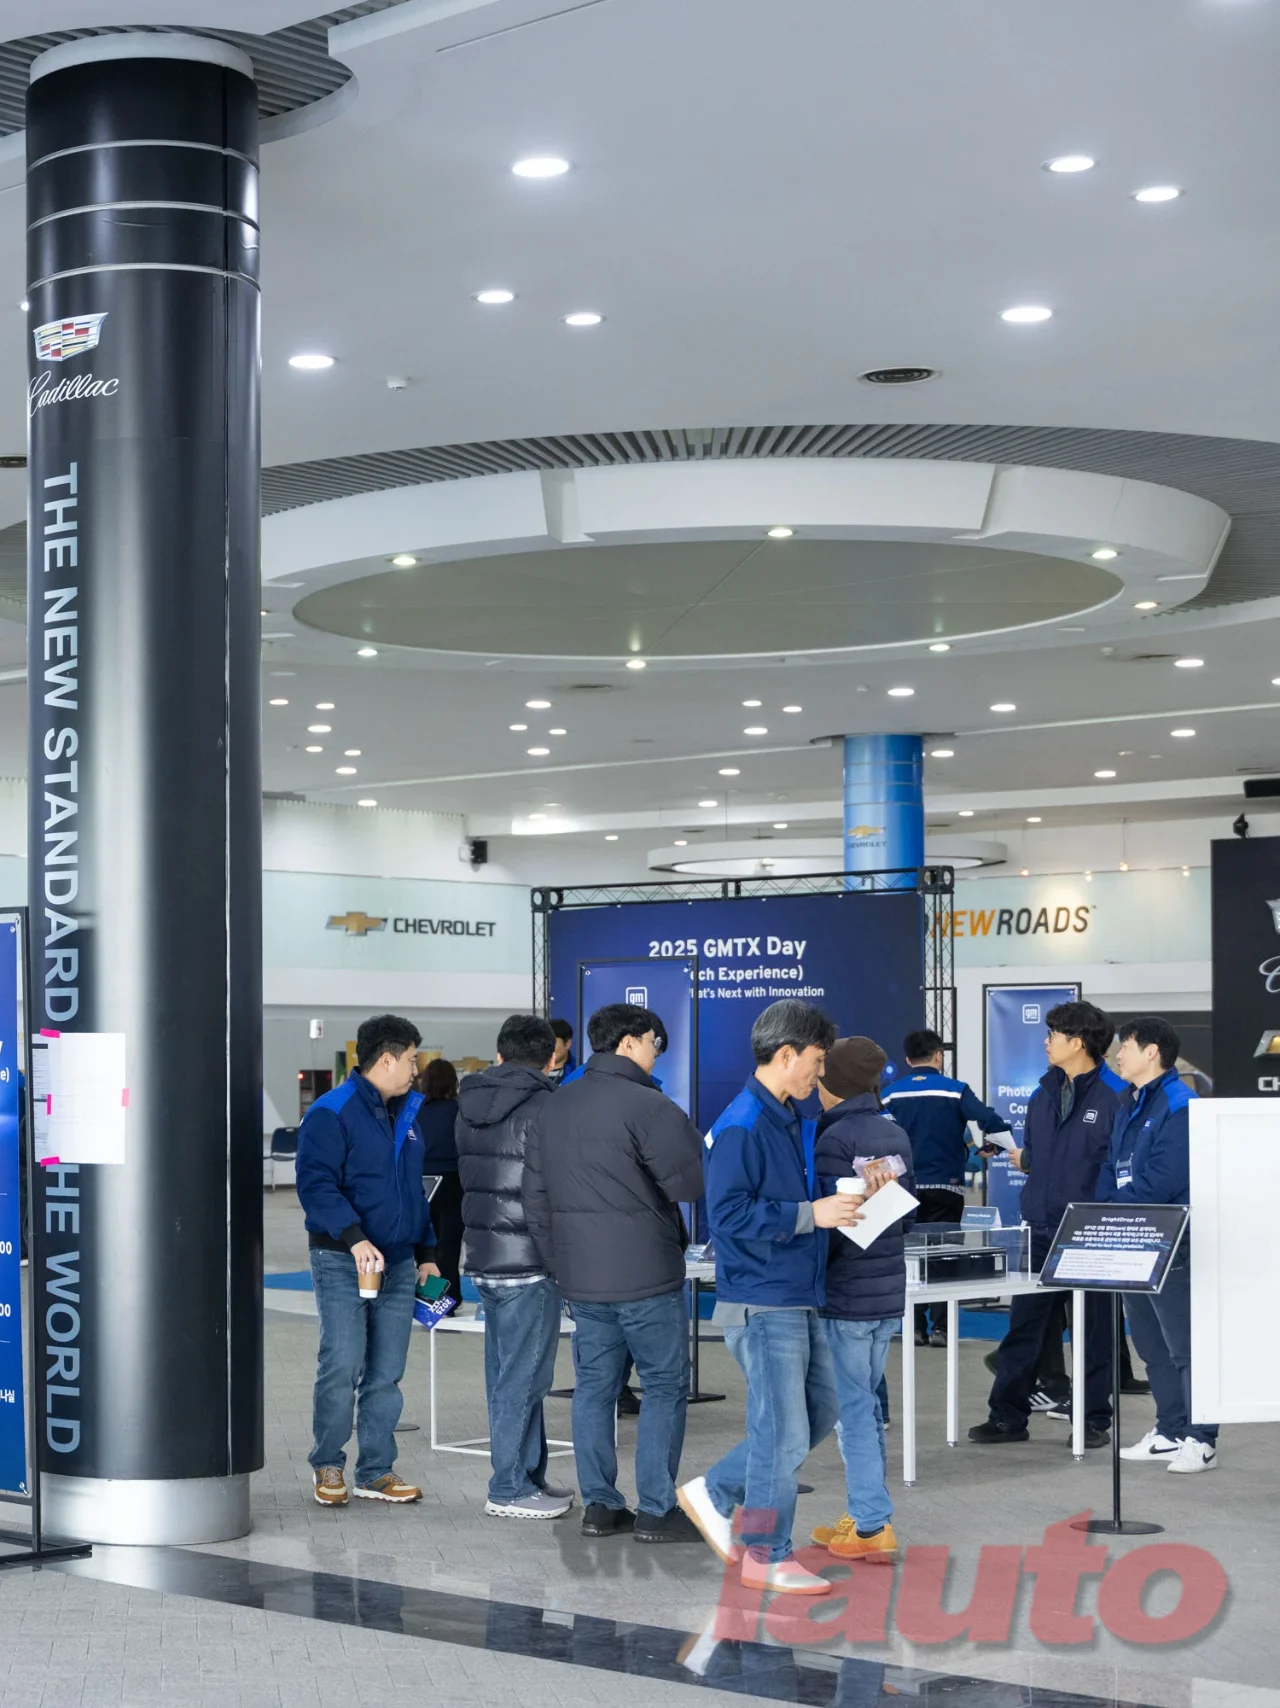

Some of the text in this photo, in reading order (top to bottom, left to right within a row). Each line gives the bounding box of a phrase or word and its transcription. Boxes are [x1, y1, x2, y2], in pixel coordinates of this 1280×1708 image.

[28, 370, 120, 418] Cadillac
[393, 917, 496, 937] CHEVROLET
[44, 462, 81, 1454] THE NEW STANDARD HE WORLD
[649, 936, 807, 960] 2025 GMTX Day
[718, 965, 803, 983] Experience)
[718, 987, 742, 998] Next
[744, 986, 766, 998] with
[768, 985, 825, 997] Innovation
